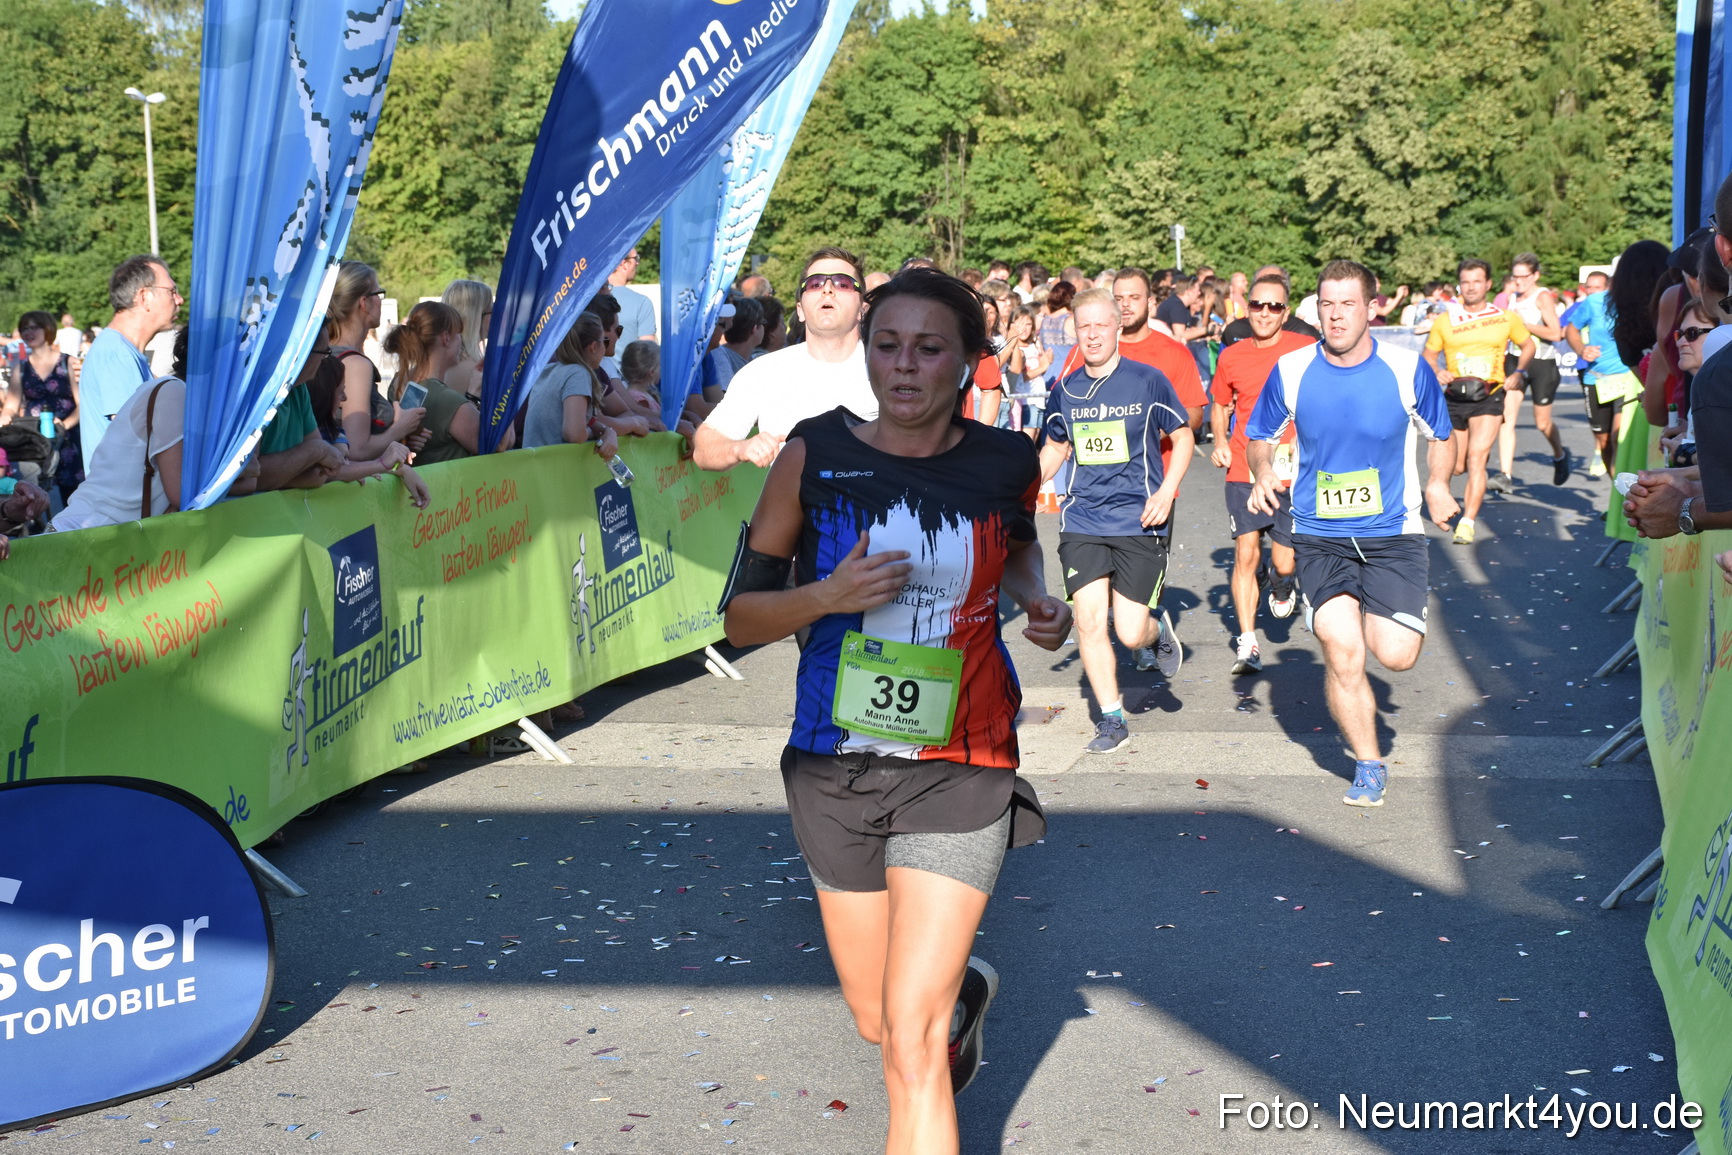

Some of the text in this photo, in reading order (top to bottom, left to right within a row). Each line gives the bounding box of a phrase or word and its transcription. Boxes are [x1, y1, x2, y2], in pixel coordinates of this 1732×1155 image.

[655, 95, 709, 157] Druck
[708, 49, 743, 97] und
[531, 19, 732, 270] Frischmann
[1071, 403, 1142, 420] EURO POLES
[1085, 437, 1114, 452] 492
[412, 477, 519, 550] Gesunde Firmen
[604, 503, 628, 526] Fischer
[1322, 487, 1371, 505] 1173
[441, 504, 533, 584] laufen länger!
[344, 565, 375, 597] Fischer
[592, 530, 676, 620] firmenlauf
[3, 547, 189, 654] Gesunde Firmen
[69, 580, 228, 697] laufen länger!
[598, 607, 635, 645] neumarkt
[310, 594, 425, 725] firmenlauf
[865, 708, 920, 727] Mann Anne
[870, 675, 920, 714] 39
[314, 700, 365, 753] neumarkt
[853, 716, 885, 729] Autohaus
[885, 723, 907, 733] Müller
[907, 728, 929, 736] GmbH
